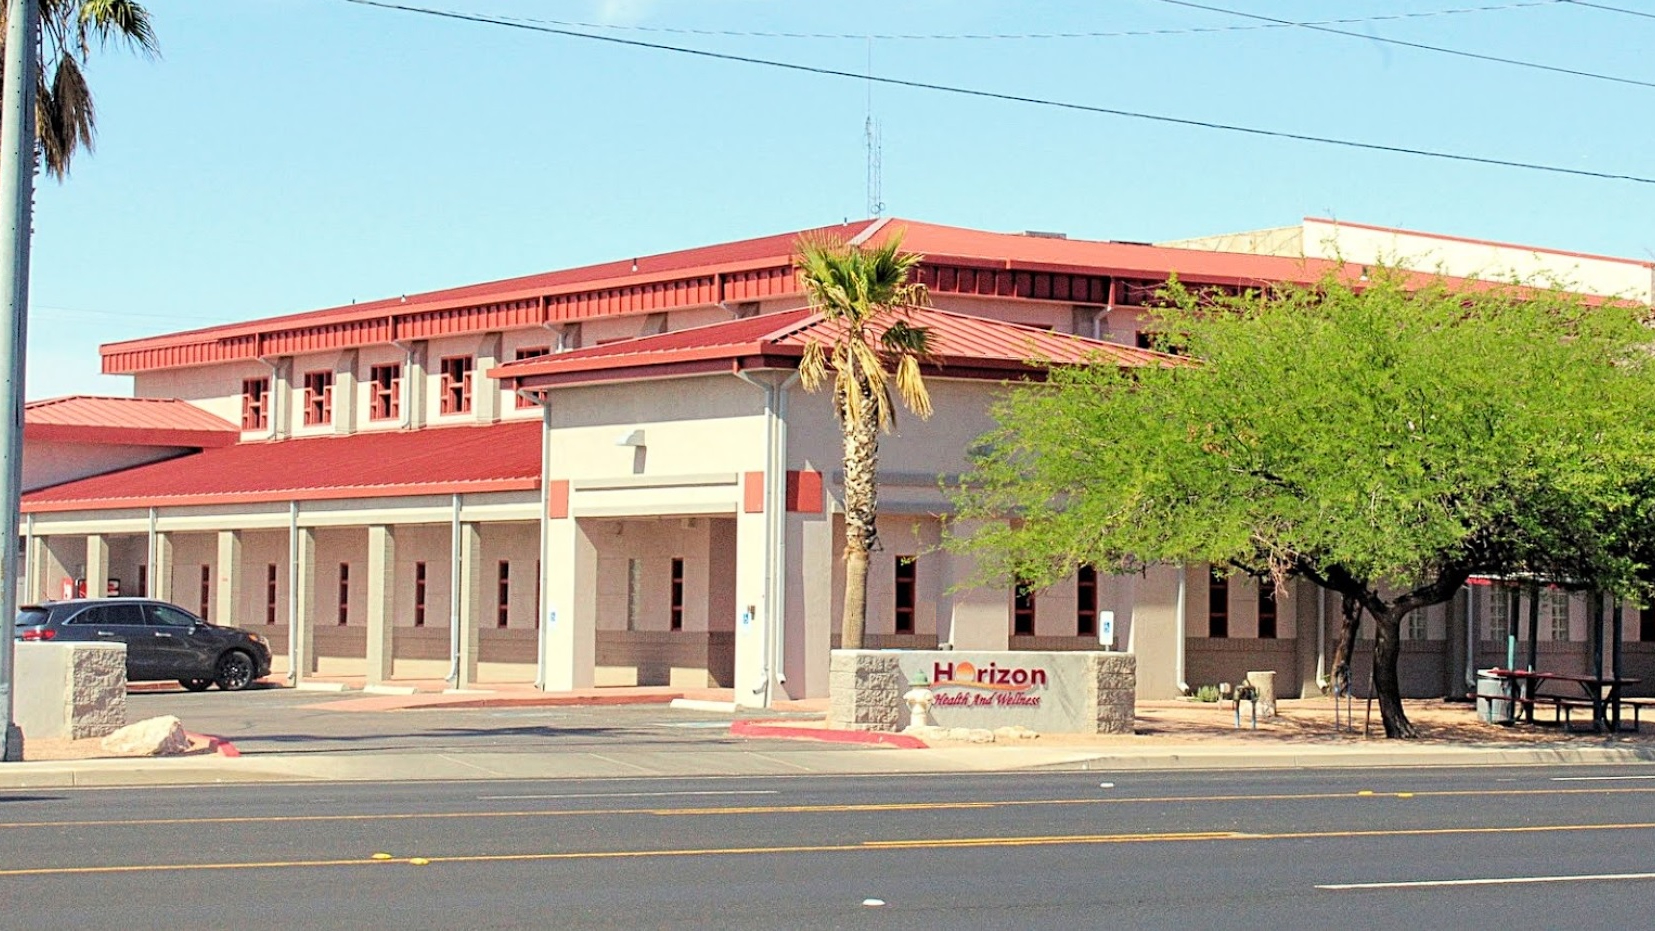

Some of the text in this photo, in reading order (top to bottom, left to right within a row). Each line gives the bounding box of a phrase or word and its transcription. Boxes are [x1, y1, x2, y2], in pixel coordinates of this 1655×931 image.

[934, 661, 1047, 685] Horizon
[933, 691, 1041, 707] Health And Wellness
